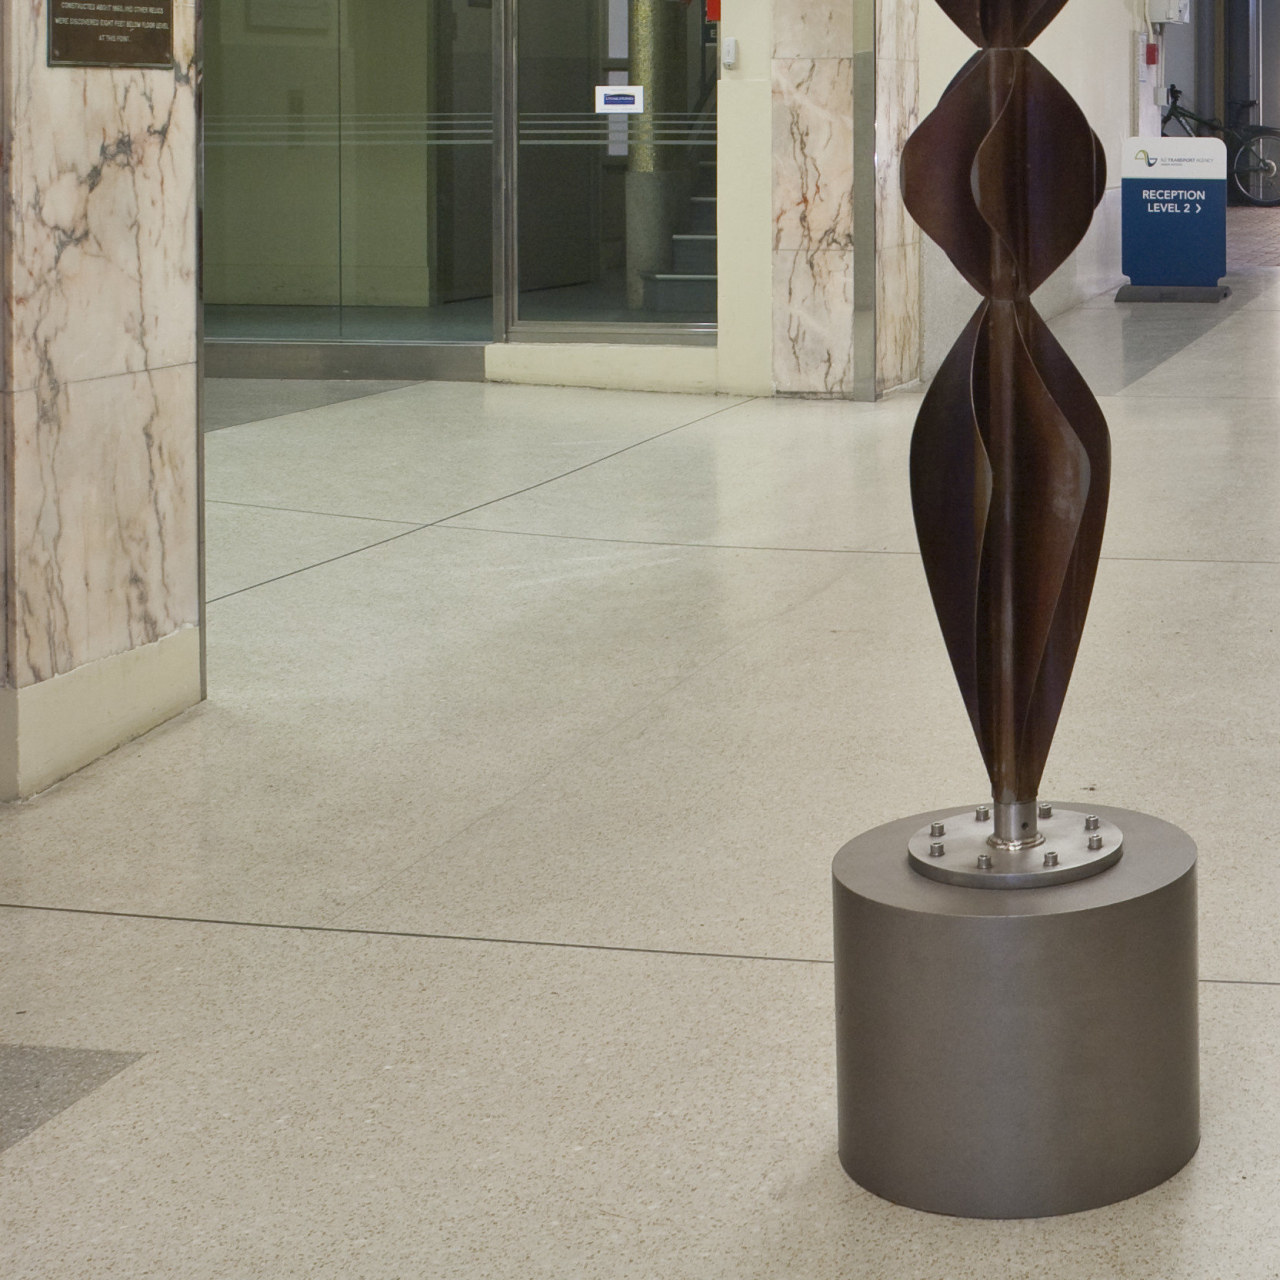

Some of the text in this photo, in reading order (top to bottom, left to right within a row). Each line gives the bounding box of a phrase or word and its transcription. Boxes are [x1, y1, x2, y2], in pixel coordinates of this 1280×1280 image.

[1142, 189, 1206, 200] RECEPTION
[1147, 203, 1190, 213] LEVEL 2
